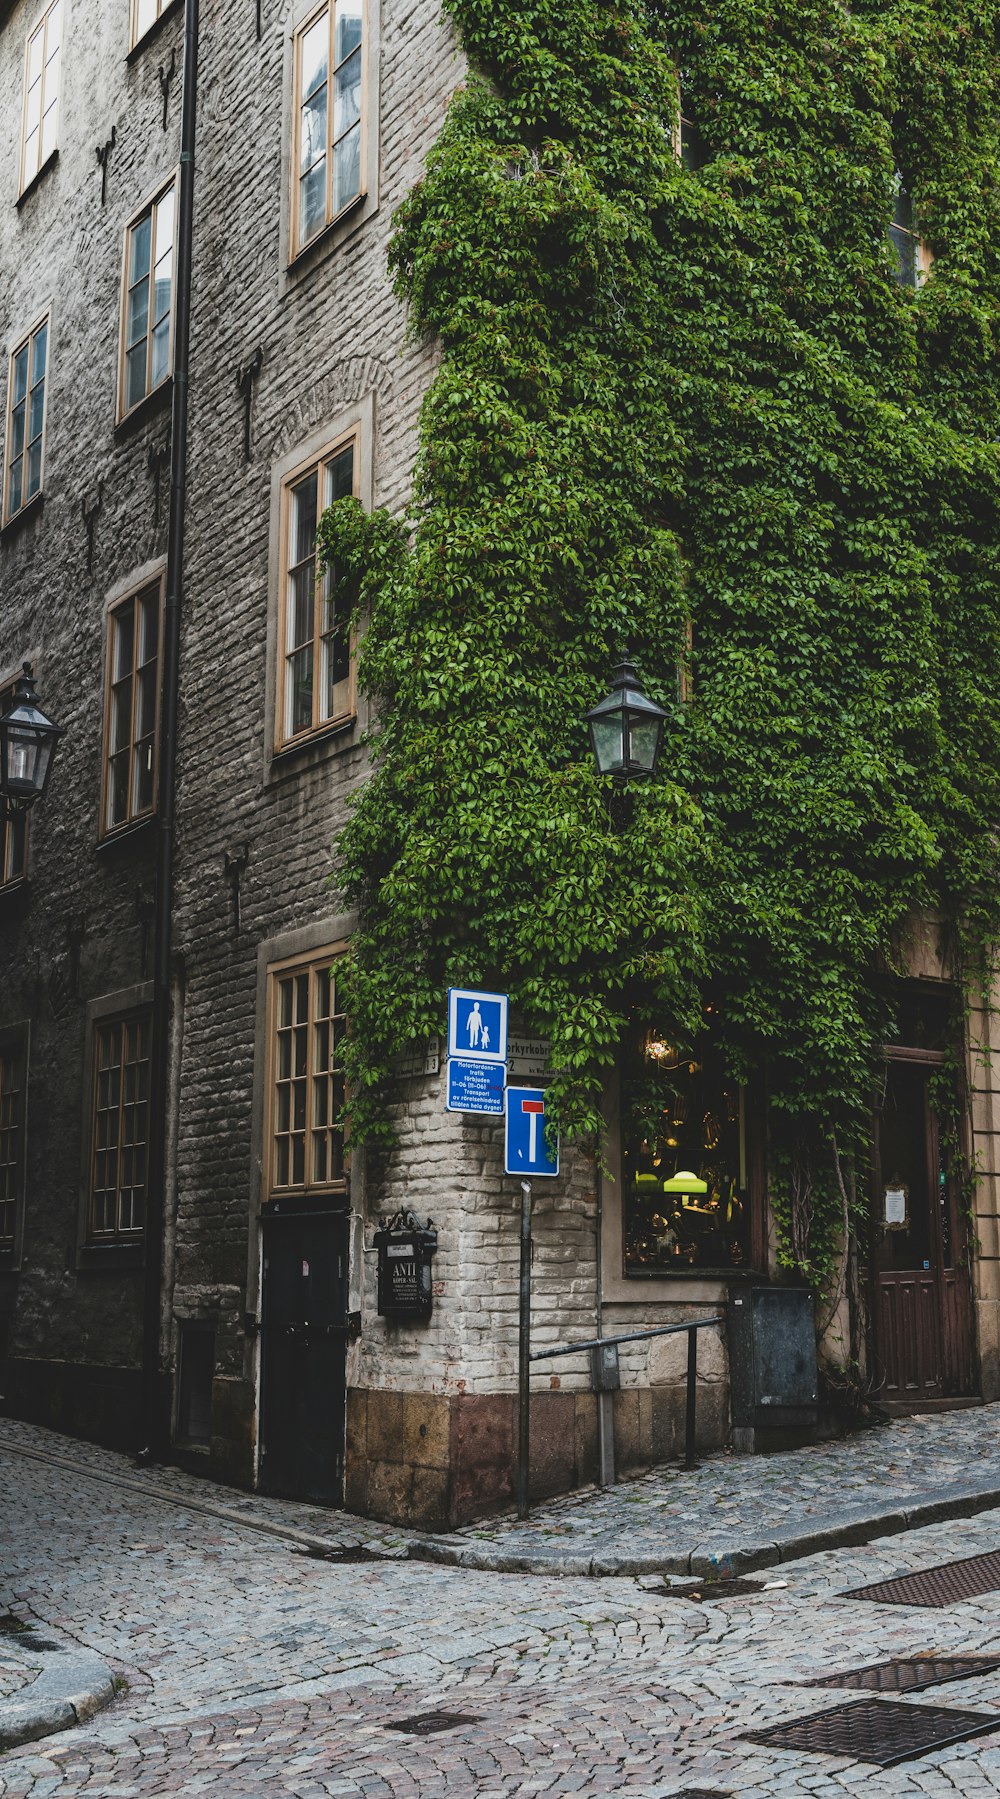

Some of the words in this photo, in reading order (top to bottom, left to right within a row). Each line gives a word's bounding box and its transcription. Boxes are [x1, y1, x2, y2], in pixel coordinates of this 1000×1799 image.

[508, 1043, 553, 1055] orkyrkobri
[458, 1062, 496, 1070] Motorfordons-
[393, 1263, 416, 1276] ANTI
